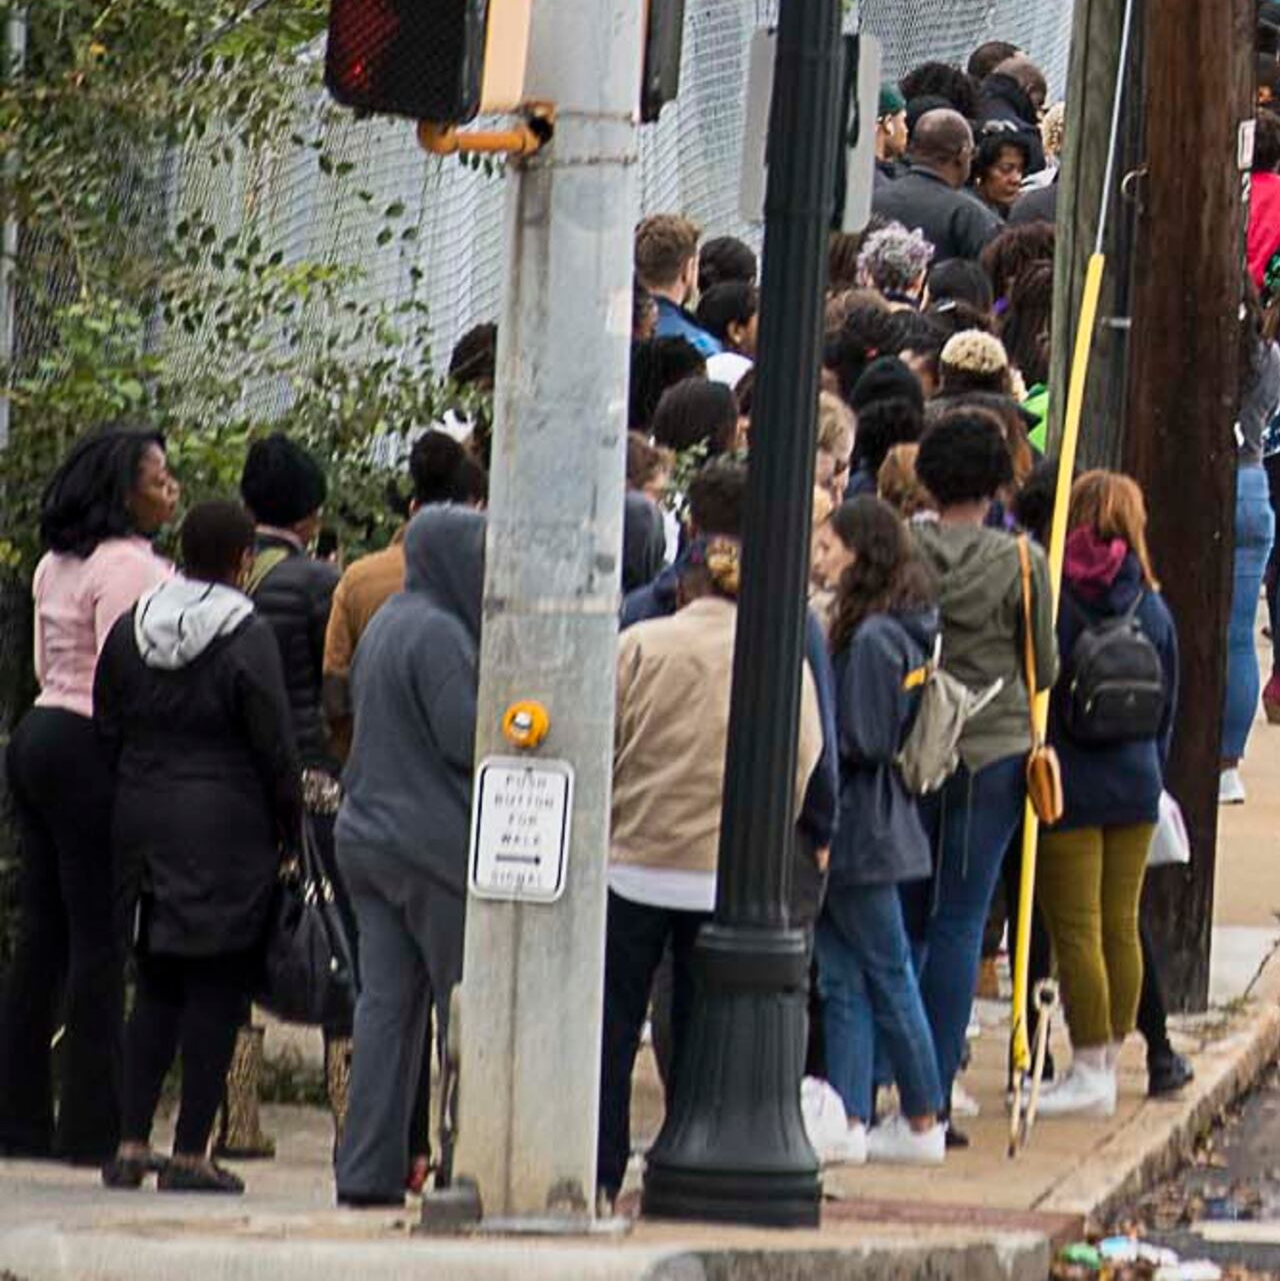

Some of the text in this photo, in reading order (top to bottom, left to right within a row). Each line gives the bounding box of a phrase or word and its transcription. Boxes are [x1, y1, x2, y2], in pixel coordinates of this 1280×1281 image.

[506, 774, 547, 788] PUSH
[494, 794, 554, 808] BUTTON
[508, 814, 538, 826] FOR
[501, 833, 541, 846] WALK
